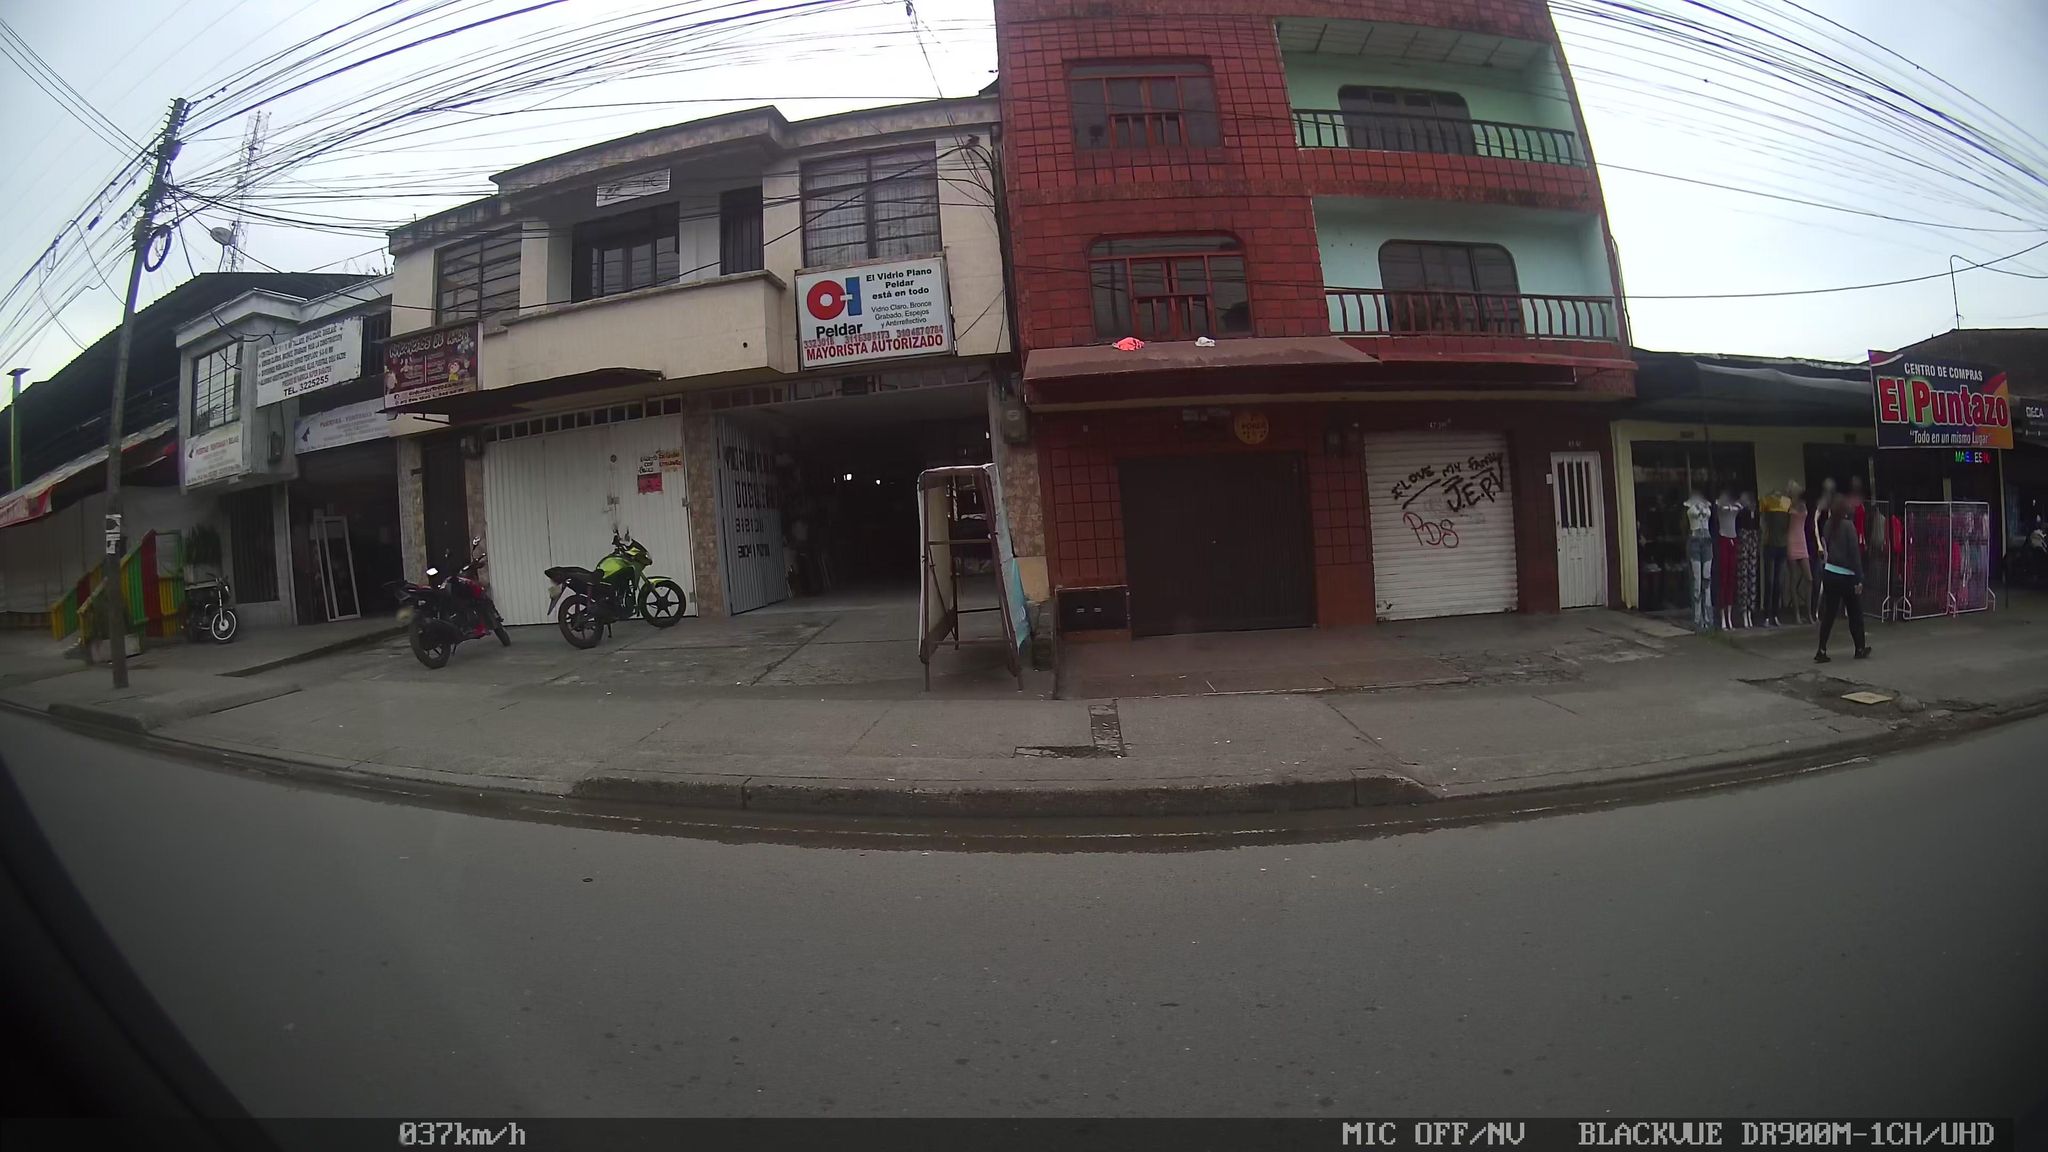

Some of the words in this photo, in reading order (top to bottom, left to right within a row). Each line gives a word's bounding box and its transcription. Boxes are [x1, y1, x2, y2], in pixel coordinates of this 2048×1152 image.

[866, 274, 875, 282] El
[877, 271, 904, 281] Vidrio
[906, 268, 932, 277] Plano
[885, 280, 915, 289] Peldar
[872, 291, 892, 300] está
[908, 287, 930, 295] todo
[871, 305, 890, 313] Vidrio
[910, 301, 932, 309] Bronce
[905, 309, 930, 318] Espejos
[816, 322, 863, 339] Peldar
[806, 341, 868, 361] MAYORISTA
[871, 334, 943, 353] AUTORIZADO
[1904, 362, 1935, 377] CENTRO
[1937, 366, 1948, 378] DE
[1949, 367, 1983, 382] COMPRAS
[300, 375, 329, 391] 3225255
[1876, 376, 1909, 424] El
[1910, 378, 2009, 428] Puntazo
[1931, 433, 1940, 444] en
[1941, 434, 1950, 444] un
[1950, 431, 1971, 444] mismo
[1400, 464, 1435, 489] LOVE
[1442, 461, 1462, 477] MY
